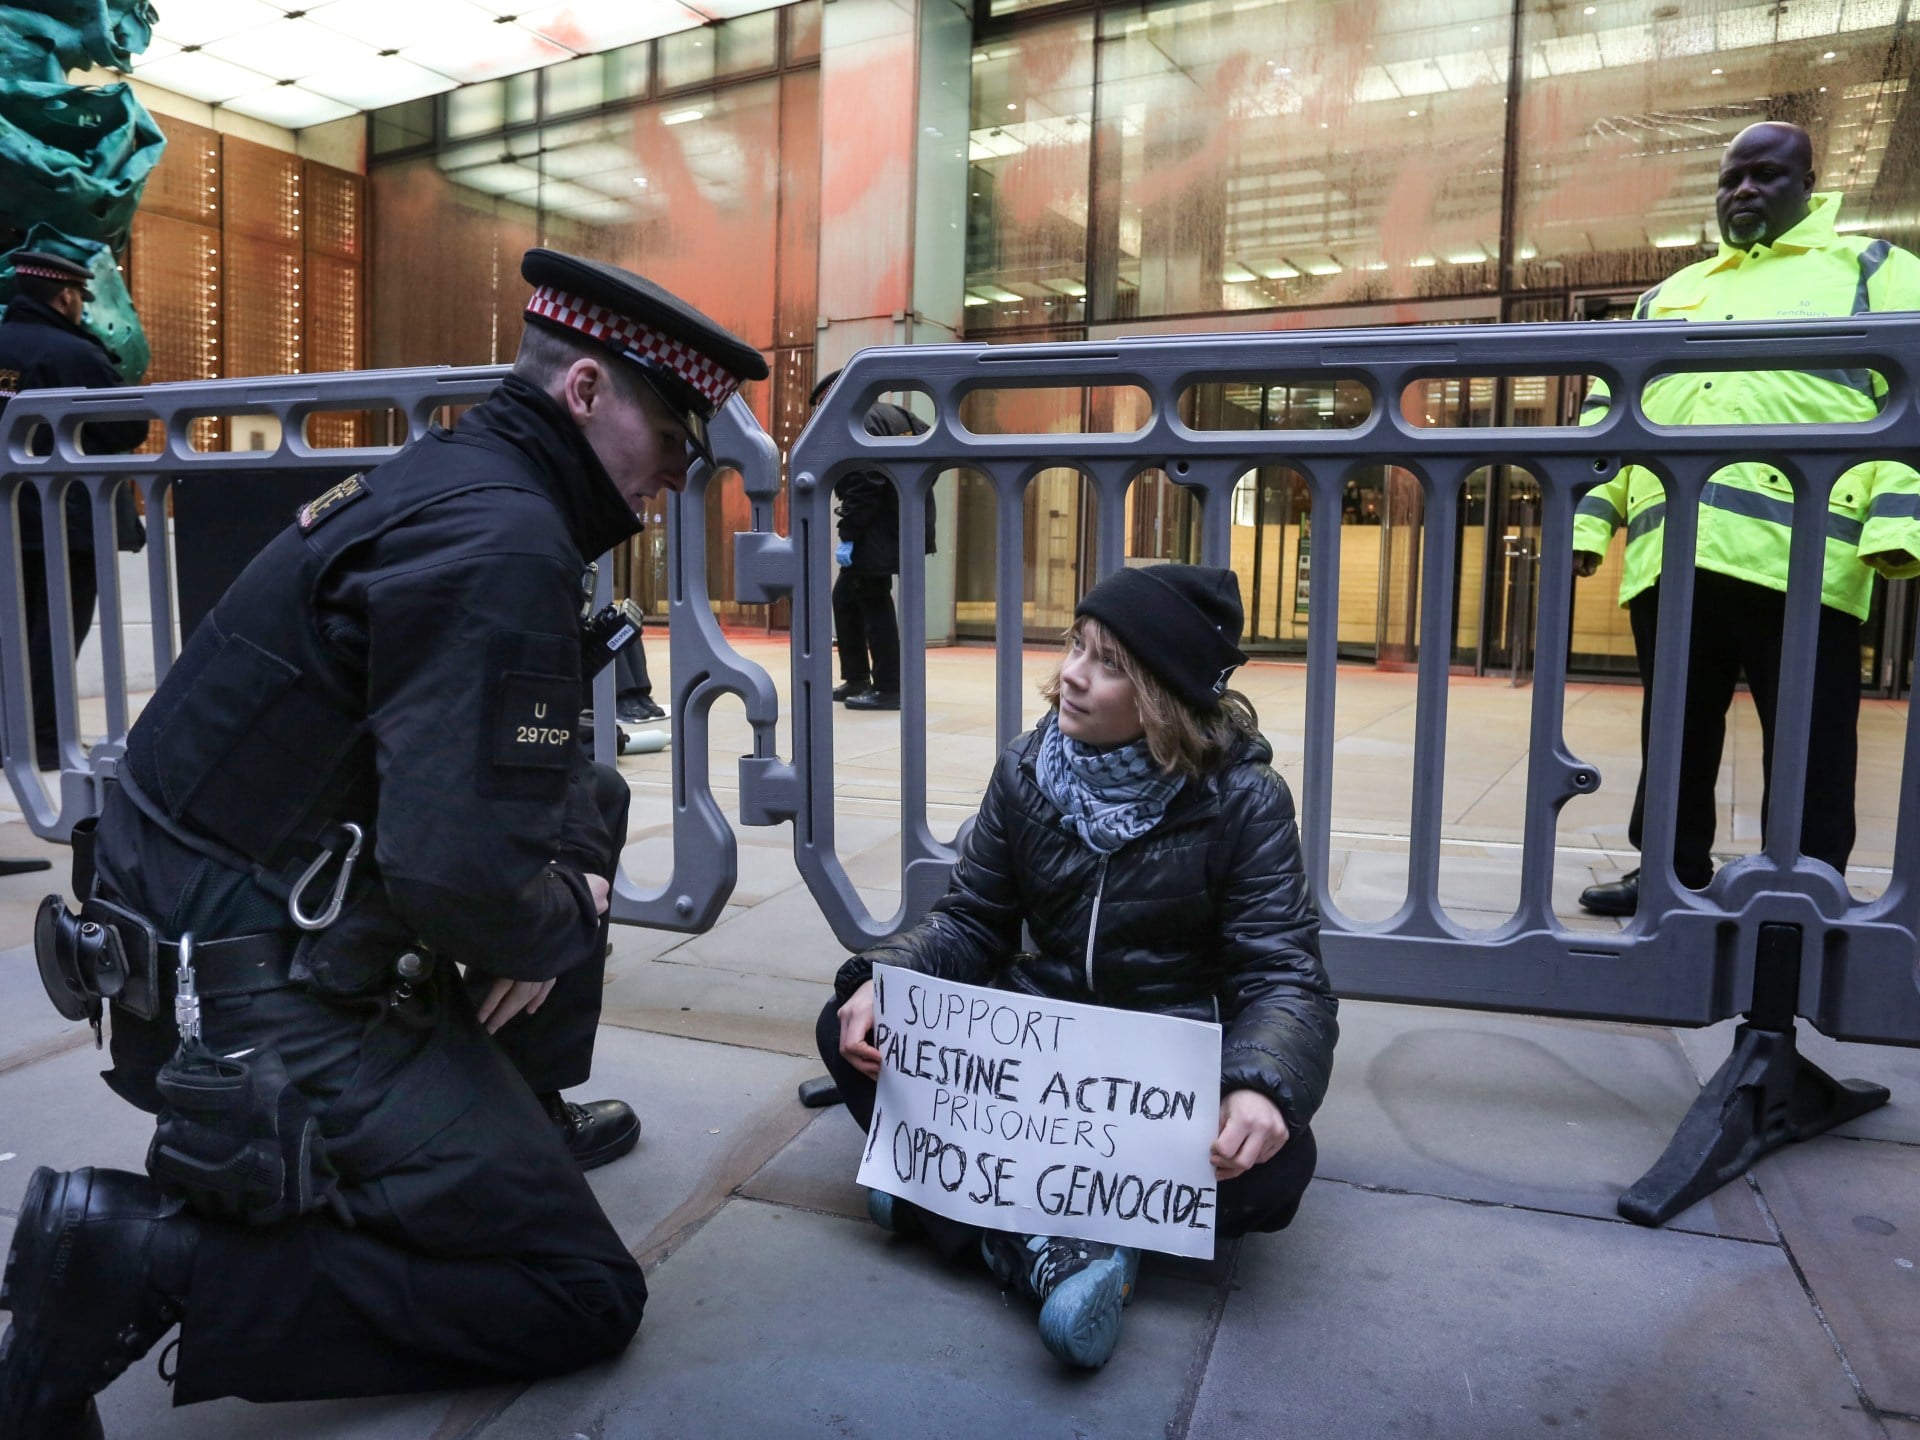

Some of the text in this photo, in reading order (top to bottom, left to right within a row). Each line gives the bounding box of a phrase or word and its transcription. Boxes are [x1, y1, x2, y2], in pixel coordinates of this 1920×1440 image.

[516, 726, 570, 745] 297CP
[534, 703, 547, 718] U
[879, 973, 1075, 1052] I SUPPORT
[875, 1022, 1196, 1121] PALESTINE ACTION
[933, 1088, 1118, 1158] PRISONERS
[865, 1107, 1216, 1229] I OPPOSE GENOCIDE
